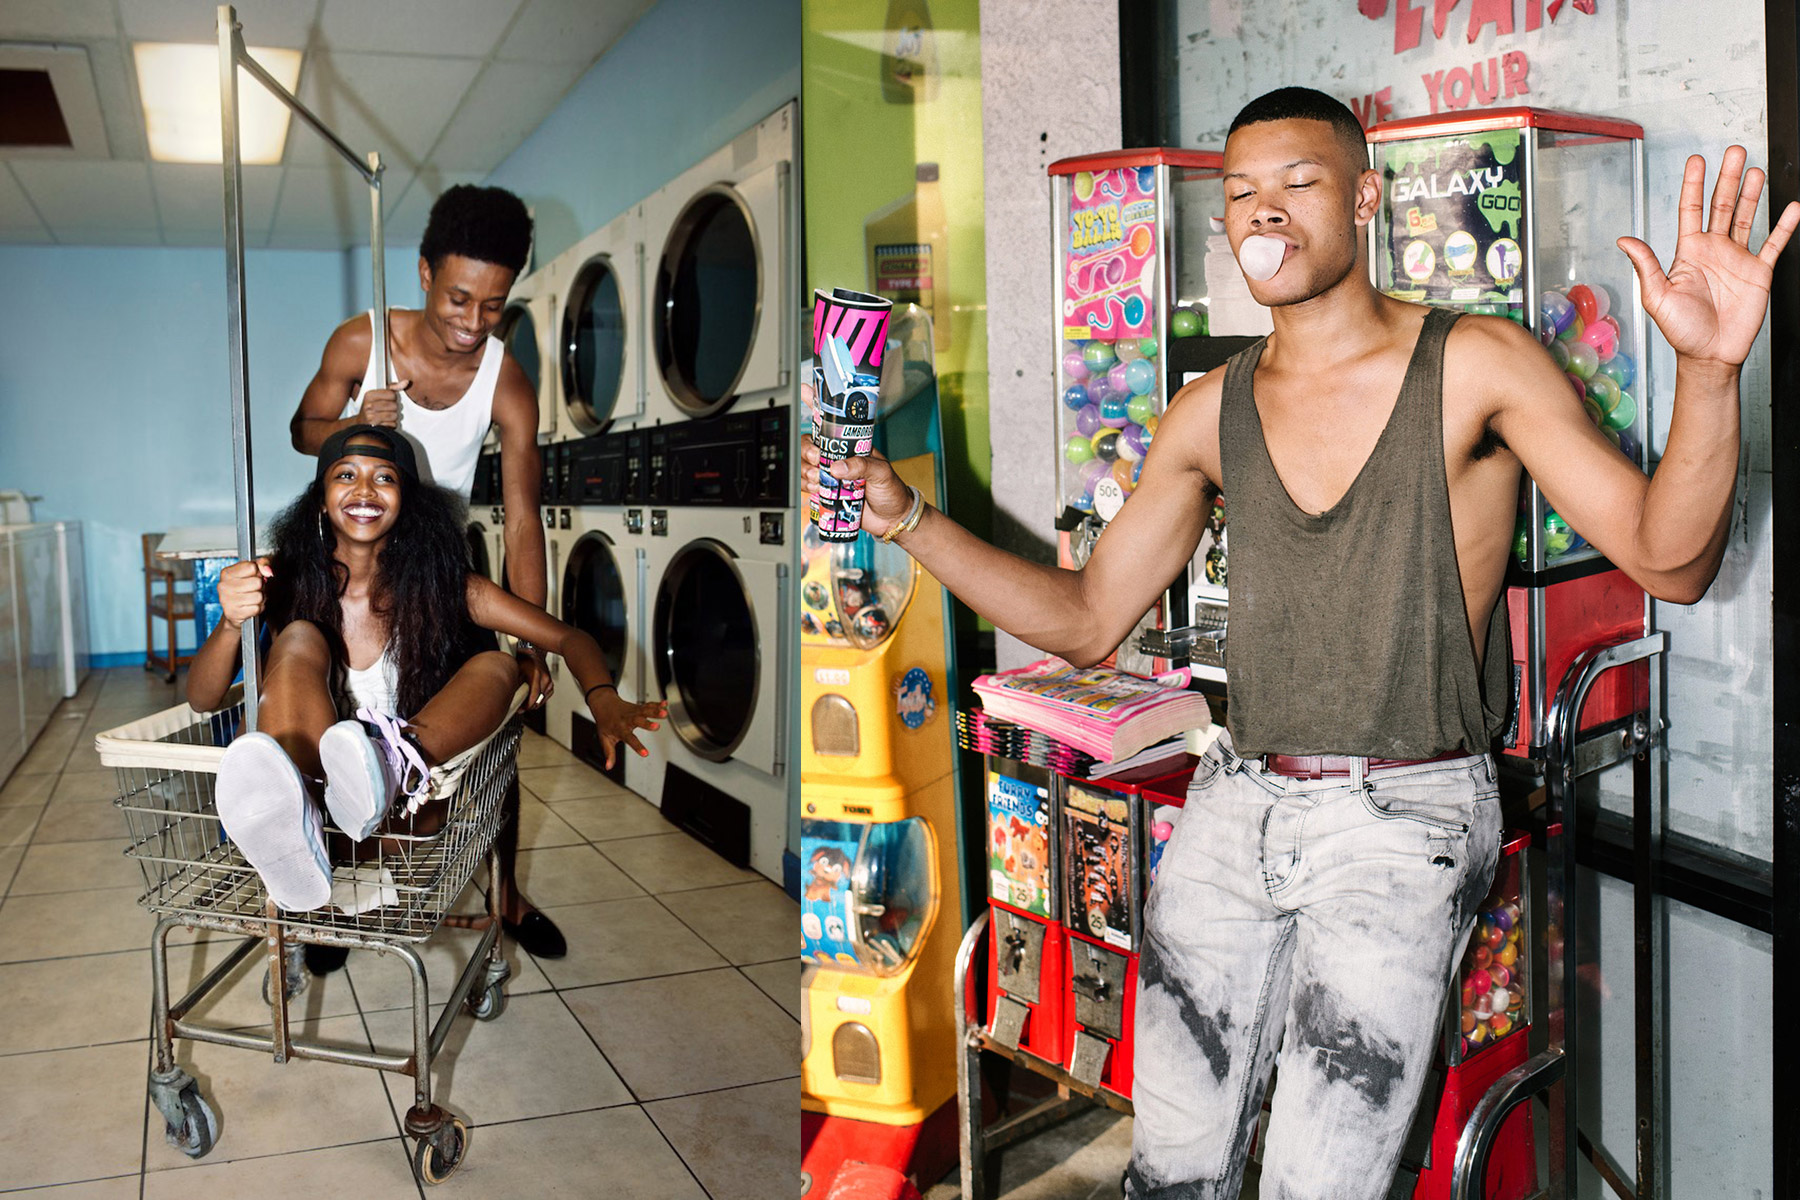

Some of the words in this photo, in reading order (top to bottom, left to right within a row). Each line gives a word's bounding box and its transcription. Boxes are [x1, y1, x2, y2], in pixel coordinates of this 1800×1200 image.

[1421, 50, 1529, 115] YOUR
[1391, 166, 1503, 203] GALAXY
[1481, 194, 1521, 212] GOO
[1073, 203, 1118, 232] YO-YO
[1072, 221, 1123, 250] BALLS
[998, 780, 1031, 801] FURRY
[843, 805, 871, 815] TOMY
[993, 793, 1034, 818] FRIENDS
